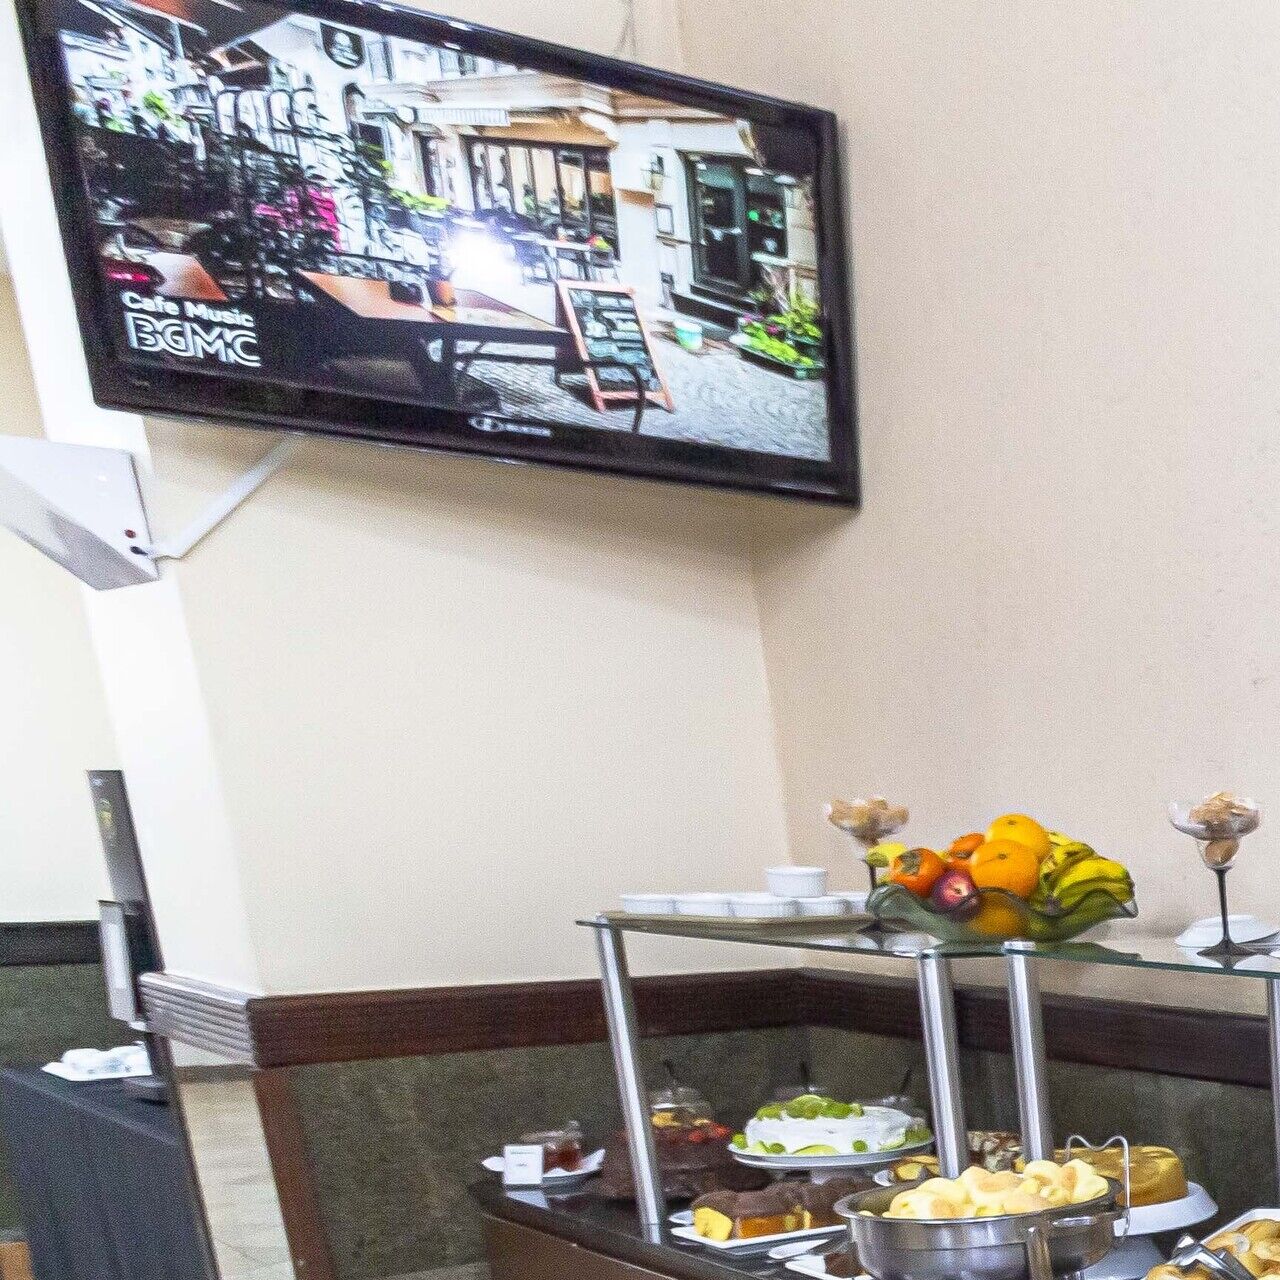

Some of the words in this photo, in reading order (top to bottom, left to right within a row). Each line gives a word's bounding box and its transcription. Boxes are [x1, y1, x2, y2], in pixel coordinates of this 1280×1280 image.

[121, 291, 179, 315] Cafe
[184, 301, 255, 327] Music
[124, 311, 261, 367] BGMC
